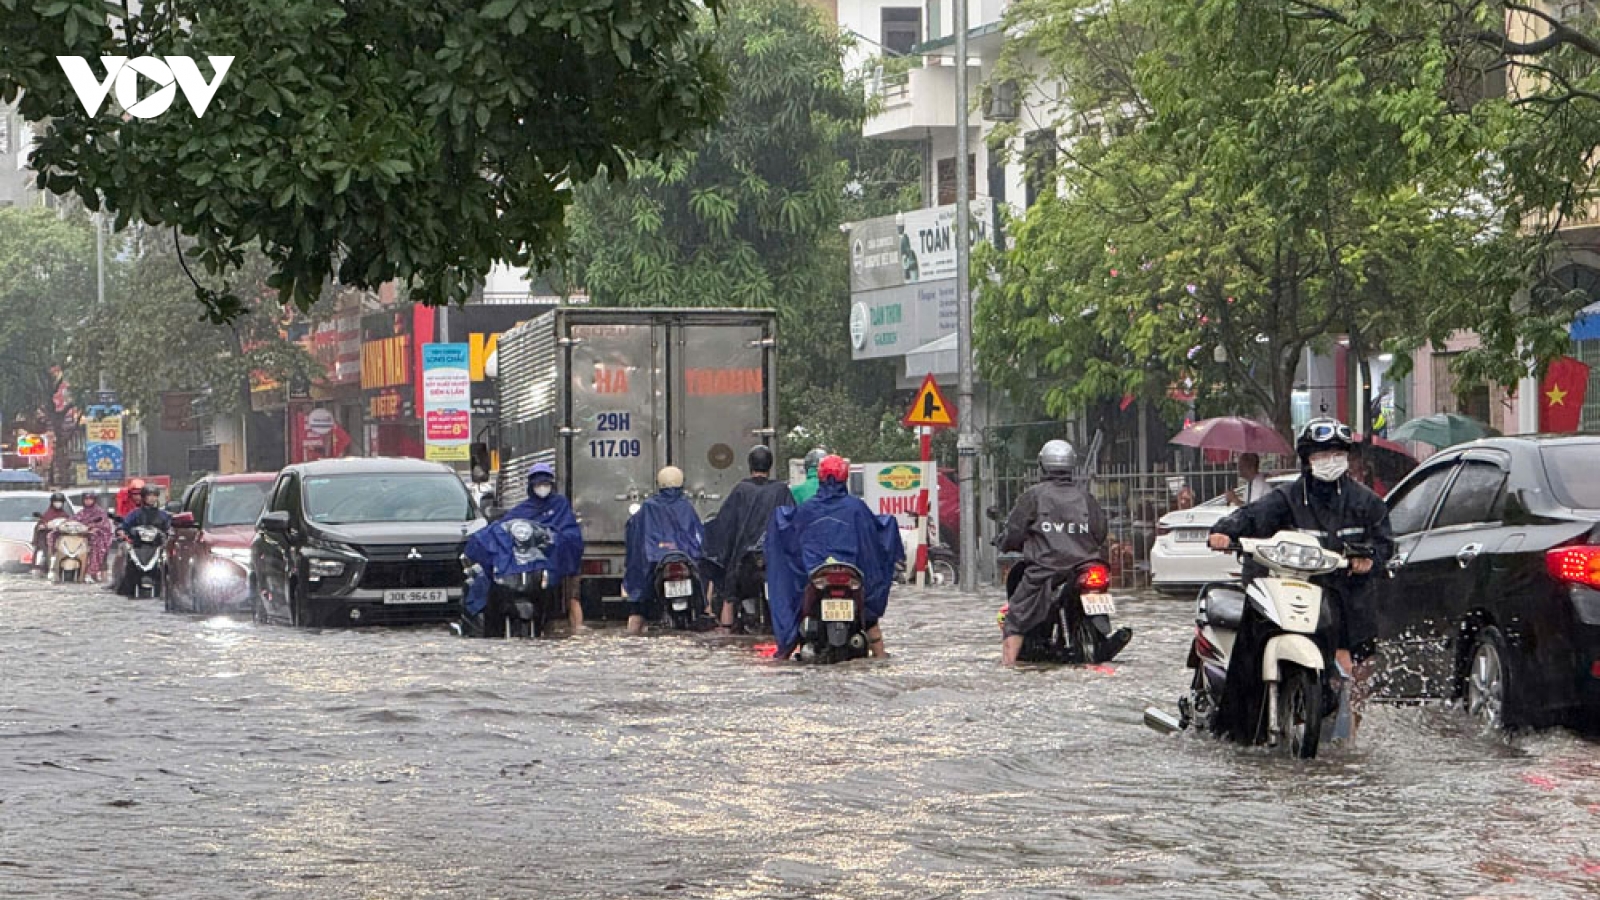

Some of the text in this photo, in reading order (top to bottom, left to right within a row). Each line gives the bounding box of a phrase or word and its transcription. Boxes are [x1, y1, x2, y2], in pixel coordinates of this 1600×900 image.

[597, 412, 631, 432] 29H
[588, 439, 642, 458] 117.09
[1041, 521, 1089, 534] OWEN
